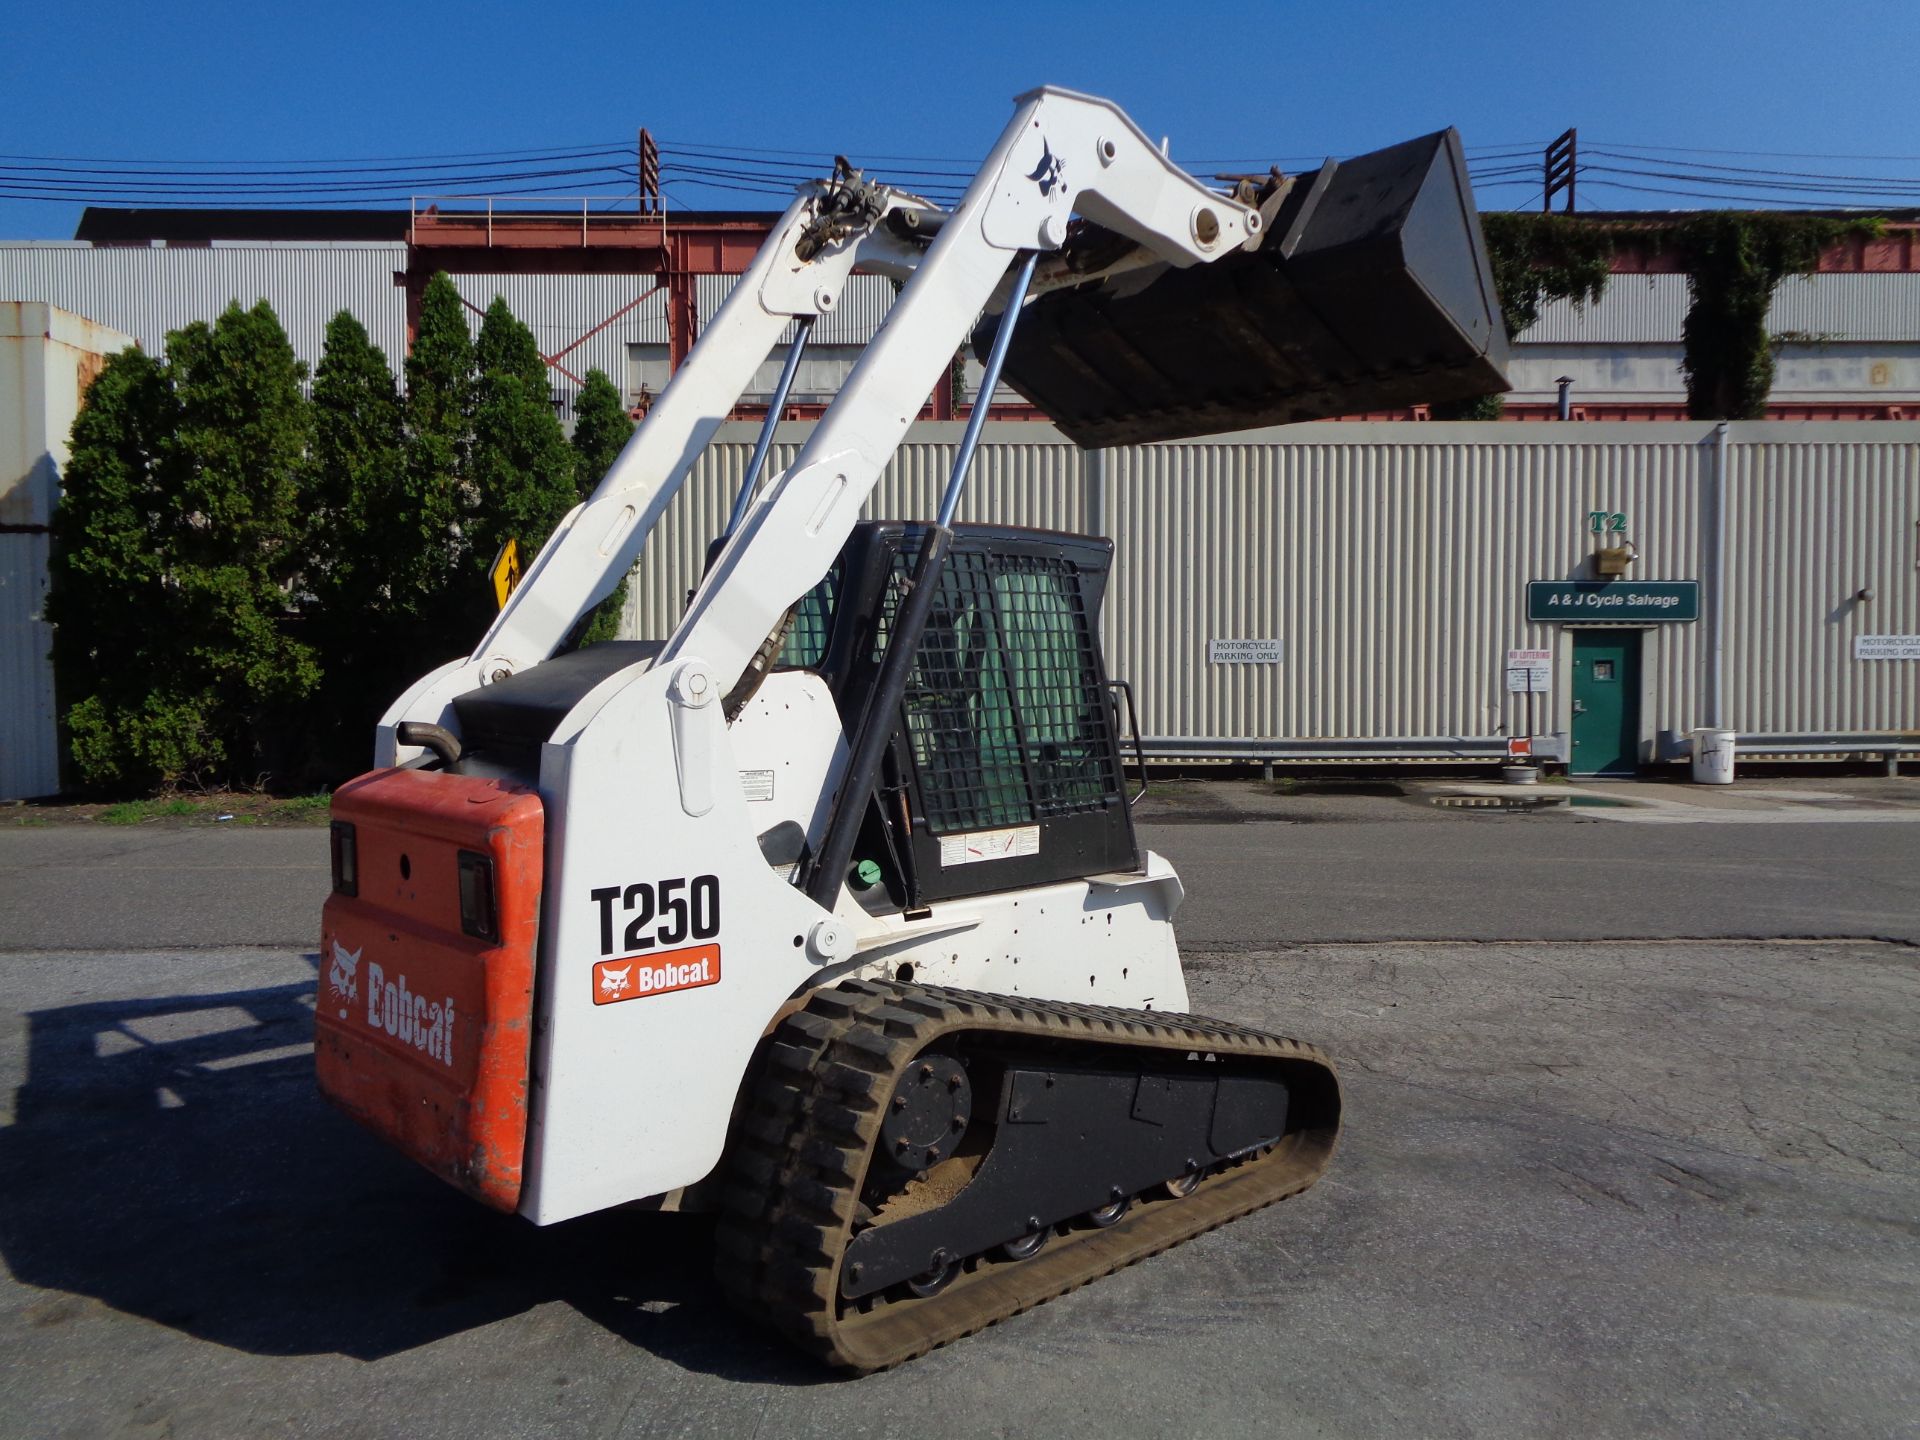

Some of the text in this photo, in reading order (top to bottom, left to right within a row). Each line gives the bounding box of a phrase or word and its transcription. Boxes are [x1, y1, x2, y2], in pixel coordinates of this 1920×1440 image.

[1548, 594, 1679, 609] A & J Cycle Salvage
[591, 874, 721, 956] T250
[639, 957, 710, 993] Bobcat
[368, 961, 455, 1067] Bobcat
